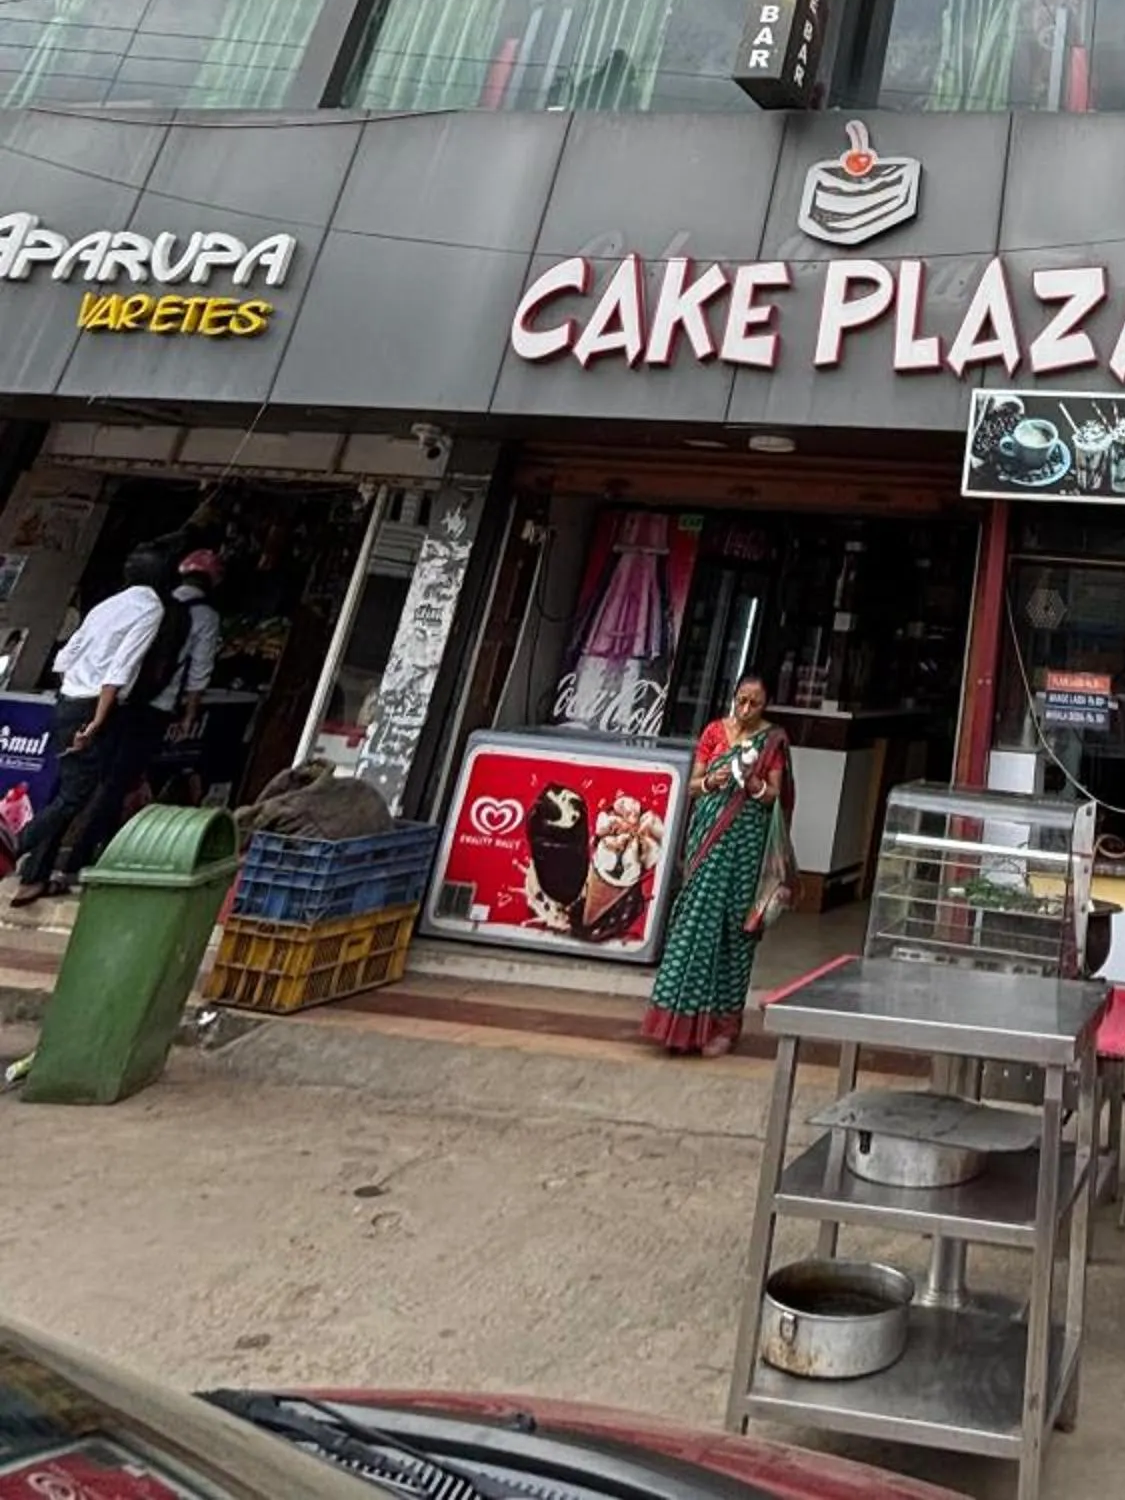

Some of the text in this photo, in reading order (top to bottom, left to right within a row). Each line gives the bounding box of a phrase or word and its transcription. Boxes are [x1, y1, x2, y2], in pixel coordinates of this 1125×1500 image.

[748, 5, 779, 68] BAR
[793, 20, 813, 87] BAR
[0, 211, 296, 285] APARUPA
[511, 253, 792, 370] CAKE
